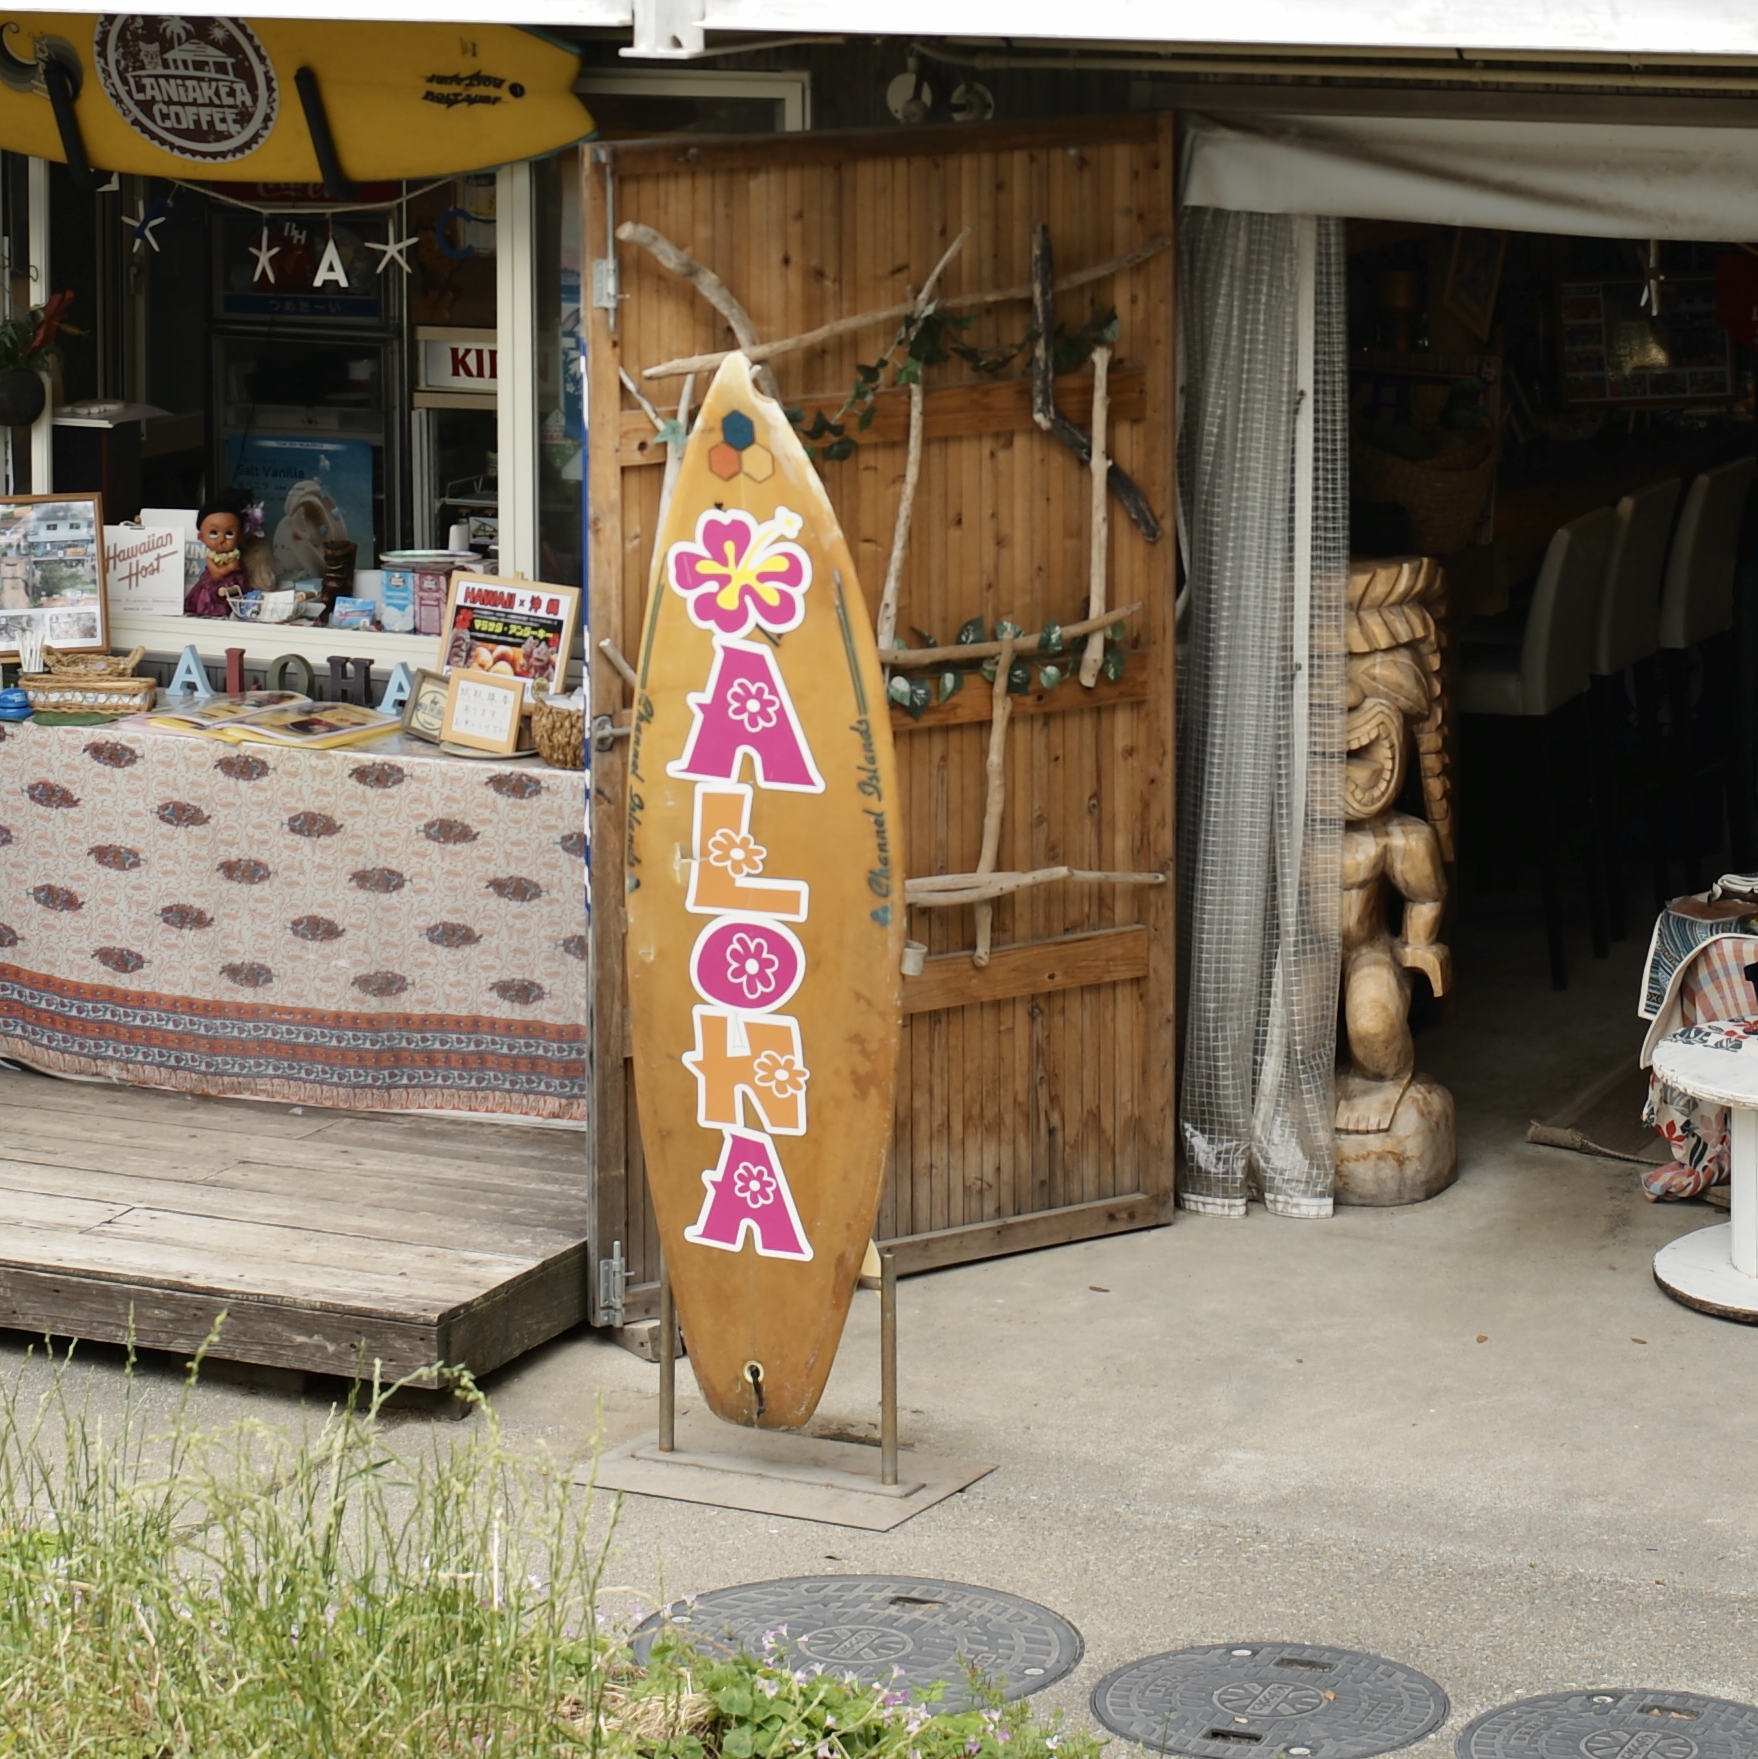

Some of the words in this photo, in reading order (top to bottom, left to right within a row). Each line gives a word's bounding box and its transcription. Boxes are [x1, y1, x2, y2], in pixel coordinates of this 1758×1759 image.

[153, 102, 243, 137] COFFEE
[238, 464, 259, 477] Salt
[261, 466, 306, 480] Vanilla
[104, 532, 174, 575] Hawaiian
[118, 550, 178, 591] Host
[849, 716, 883, 804] Islands
[862, 807, 891, 899] Channel
[666, 638, 826, 1262] ALOHA
